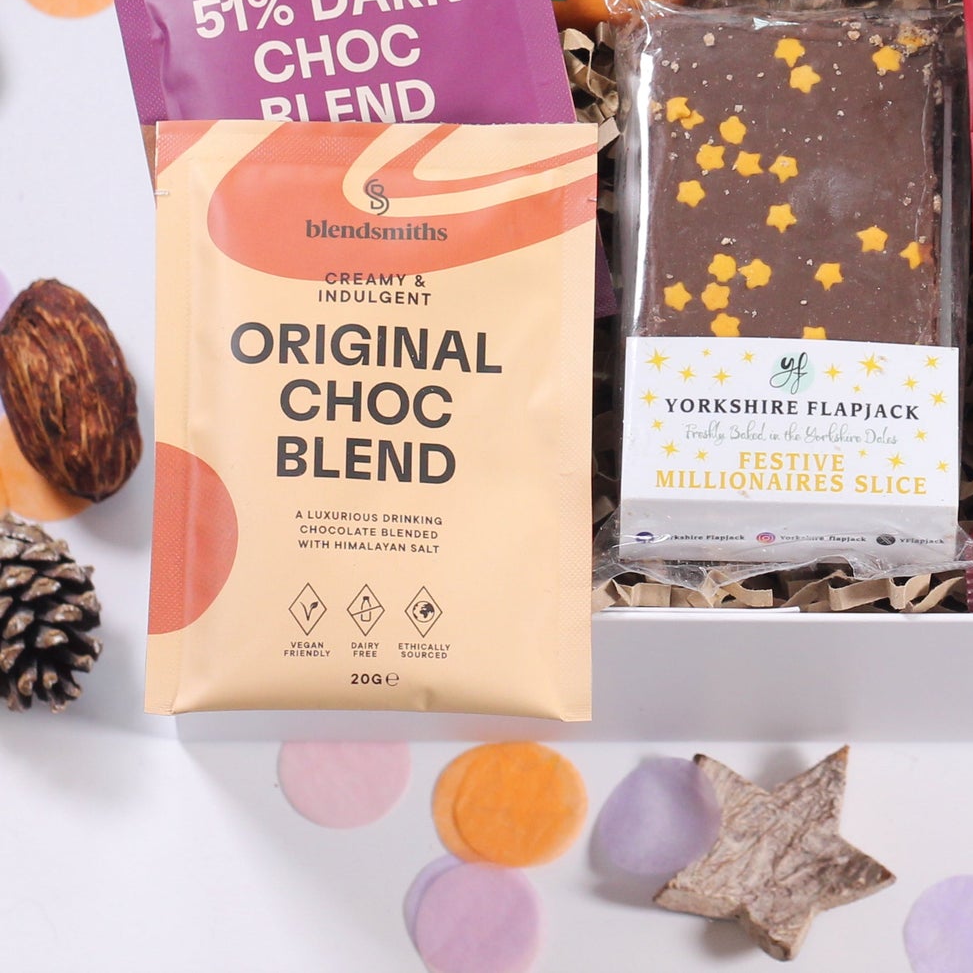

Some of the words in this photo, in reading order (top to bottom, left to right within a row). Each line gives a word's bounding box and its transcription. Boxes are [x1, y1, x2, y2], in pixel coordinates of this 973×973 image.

[254, 23, 422, 84] CHOC
[305, 219, 448, 241] blendsmiths
[325, 272, 407, 287] CREAMY
[414, 274, 426, 288] &
[318, 290, 432, 306] INDULGENT
[230, 321, 503, 374] ORIGINAL
[280, 379, 453, 429] CHOC
[664, 397, 799, 416] YORKSHIRE
[807, 400, 920, 421] FLAPJACK
[683, 421, 726, 445] Freshly
[730, 421, 764, 440] Baked
[769, 432, 781, 441] in
[784, 423, 800, 442] the
[804, 421, 861, 444] Yorkshire
[864, 425, 898, 445] Dales
[276, 436, 456, 484] BLEND
[739, 451, 845, 472] FESTIVE
[655, 470, 845, 493] MILLIONAIRES
[854, 475, 928, 495] SLICE
[295, 510, 303, 519] A
[307, 510, 378, 522] LUXURIOUS
[383, 514, 443, 525] DRINKING
[300, 525, 376, 536] CHOCOLATE
[381, 528, 438, 539] BLENDED
[298, 539, 329, 549] WITH
[334, 540, 406, 552] HIMALAYAN
[411, 544, 440, 554] SALT
[284, 649, 330, 657] FRIENDLY
[291, 641, 324, 649] VEGAN
[351, 642, 380, 650] DAIRY
[398, 642, 450, 651] ETHICALLY
[353, 650, 377, 658] FREE
[401, 651, 448, 659] SOURCED
[350, 673, 382, 685] 20G
